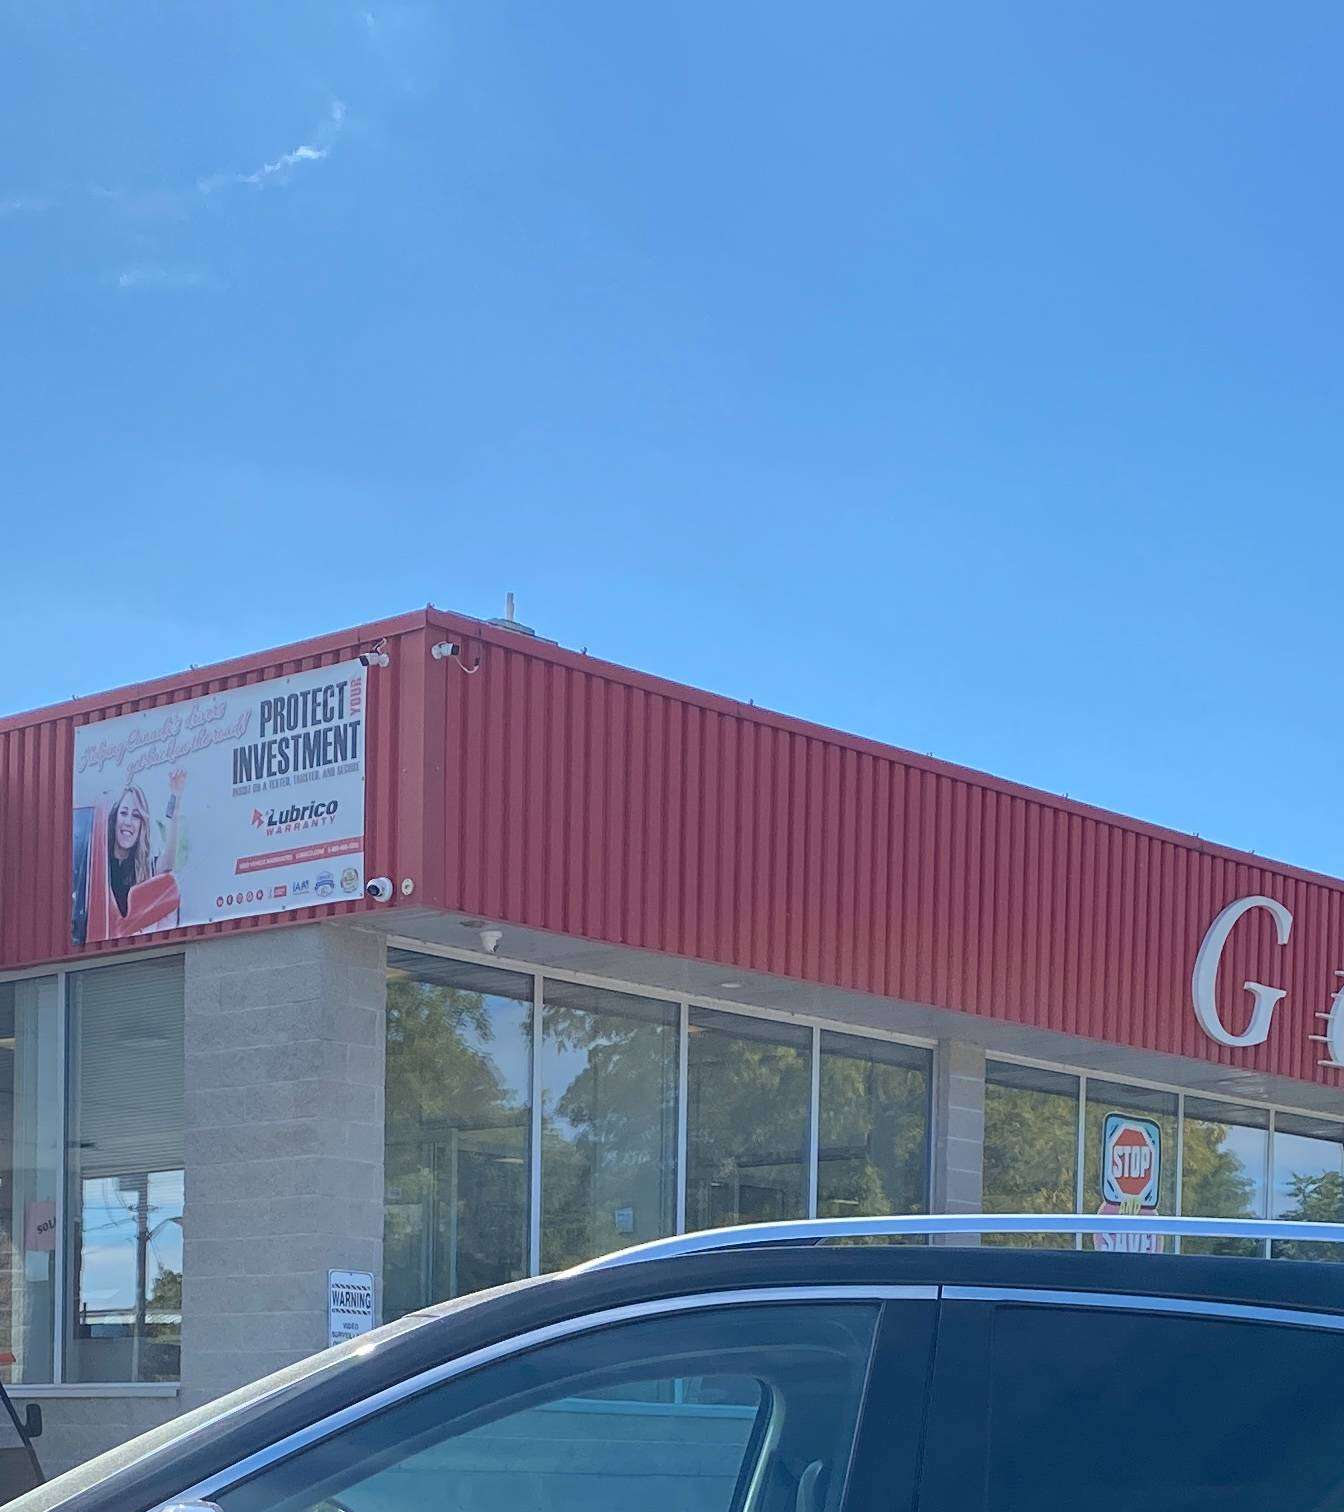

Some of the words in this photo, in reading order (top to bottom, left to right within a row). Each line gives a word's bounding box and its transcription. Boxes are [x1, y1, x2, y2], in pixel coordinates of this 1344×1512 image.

[260, 681, 347, 737] PROTECT
[350, 675, 361, 716] YOUR
[233, 720, 360, 784] INVESTMENT
[266, 815, 336, 836] WARRANTY
[267, 800, 338, 827] Lubrico
[1112, 1145, 1151, 1178] STOP
[36, 1216, 56, 1234] SOL
[332, 1290, 371, 1309] WARNING
